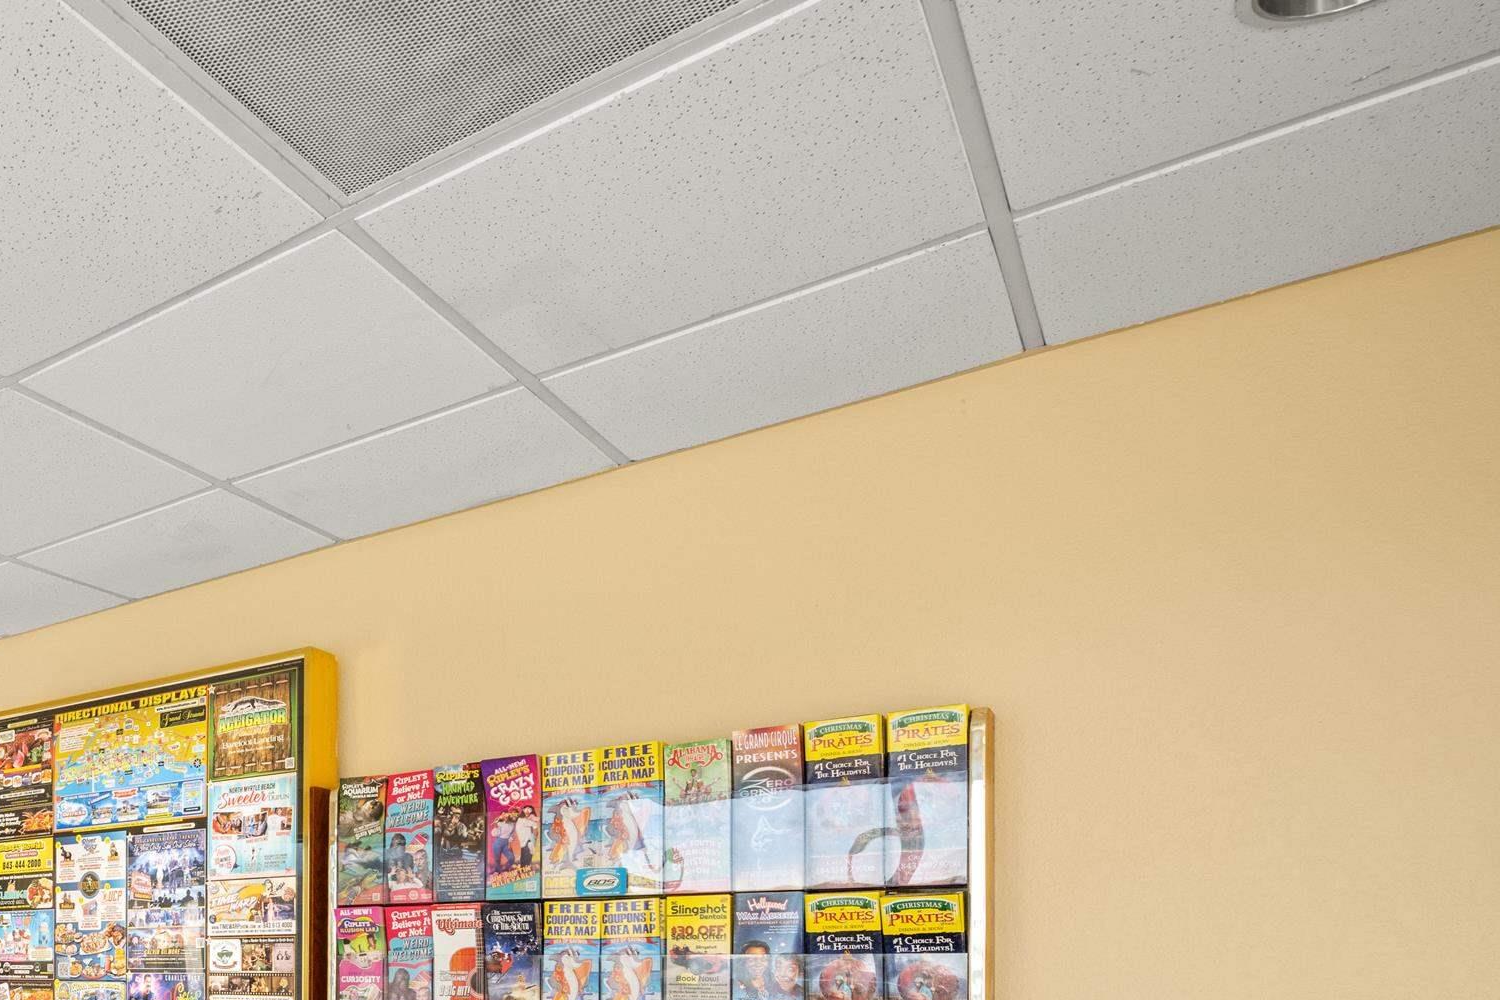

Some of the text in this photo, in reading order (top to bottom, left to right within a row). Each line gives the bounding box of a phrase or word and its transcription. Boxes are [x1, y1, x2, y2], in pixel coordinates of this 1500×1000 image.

[56, 686, 207, 724] DIRECTIONAL DISPLAYS
[218, 708, 287, 735] ALLIGATOR
[903, 712, 949, 724] CHRISTMAS
[820, 723, 862, 735] CHRISTMAS
[895, 724, 960, 742] PIRATES
[222, 734, 284, 750] Barefoot Landing
[812, 734, 873, 751] PIRATES
[604, 744, 653, 759] FREE
[736, 750, 798, 764] PRESENTS
[545, 752, 592, 766] FREE
[393, 772, 428, 787] RIPLEY'S
[435, 769, 479, 784] RIPLEY'S
[545, 775, 594, 788] AREA MAP
[603, 768, 655, 782] AREA MAP
[261, 782, 276, 790] BEACH
[490, 773, 535, 799] CRAZY
[218, 790, 268, 809] Sweeter
[437, 793, 478, 808] ADVENTURE
[499, 787, 534, 805] GOLF
[549, 903, 596, 914] FREE
[603, 900, 651, 912] FREE
[671, 904, 727, 916] Slingshot
[747, 897, 789, 914] Hollywood
[821, 899, 865, 907] CHRISTMAS
[897, 902, 943, 910] CHRISTMAS
[391, 909, 428, 920] RIPLEY'S
[814, 911, 874, 924] PIRATES
[889, 913, 955, 927] PIRATES
[435, 919, 484, 936] Ultimate
[547, 925, 597, 936] AREA MAP
[603, 923, 656, 935] AREA MAP
[671, 925, 725, 936] $30 OFF
